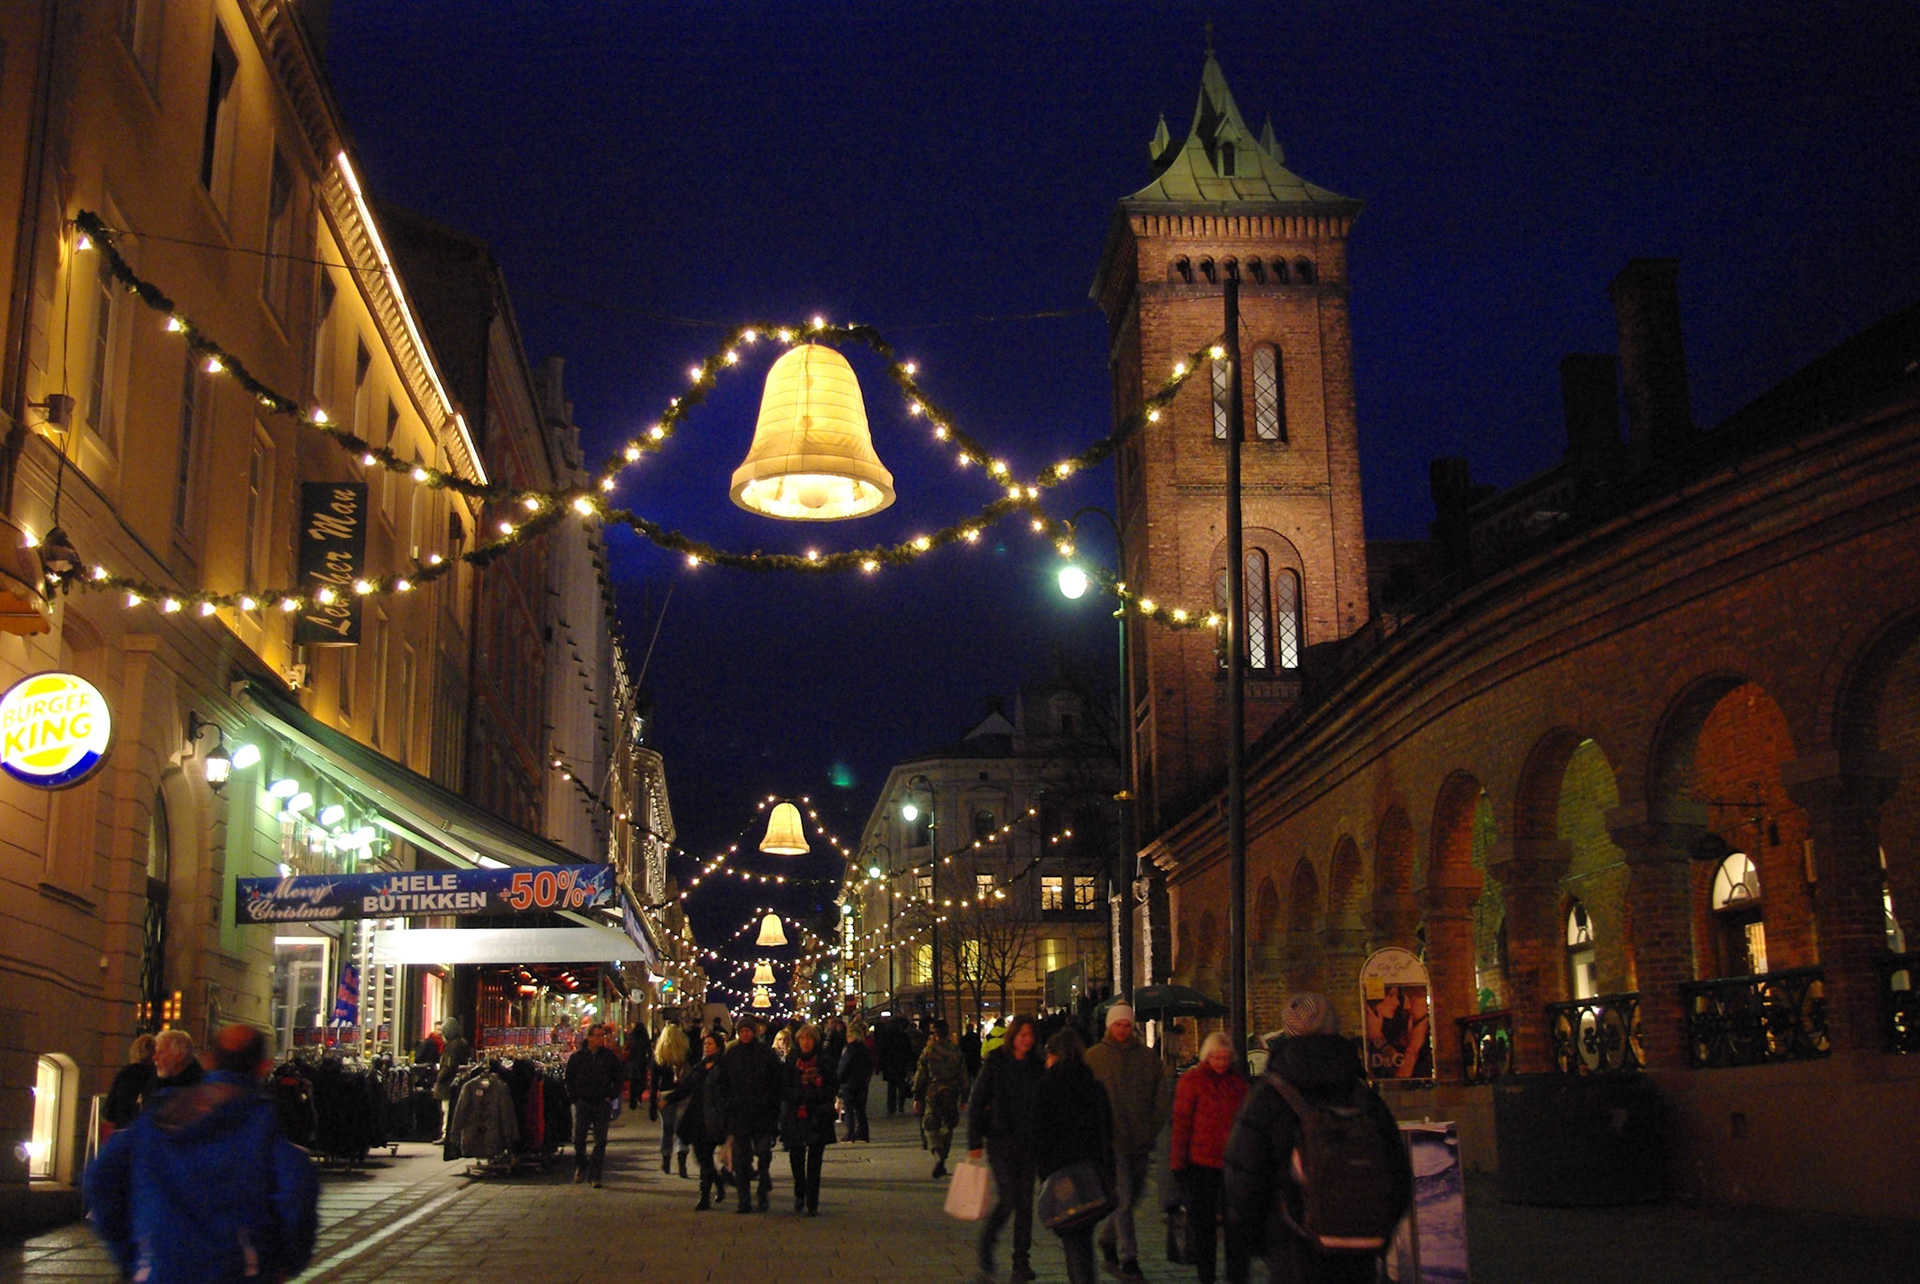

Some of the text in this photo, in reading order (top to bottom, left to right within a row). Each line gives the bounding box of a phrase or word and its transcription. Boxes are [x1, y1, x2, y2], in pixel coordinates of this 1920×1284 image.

[306, 488, 357, 636] Leaher Man
[2, 692, 92, 728] BURGER
[4, 712, 92, 758] KING
[266, 877, 333, 904] Merry
[391, 874, 458, 892] HELE
[247, 898, 344, 920] Christmas
[363, 891, 487, 913] BUTIKKEN
